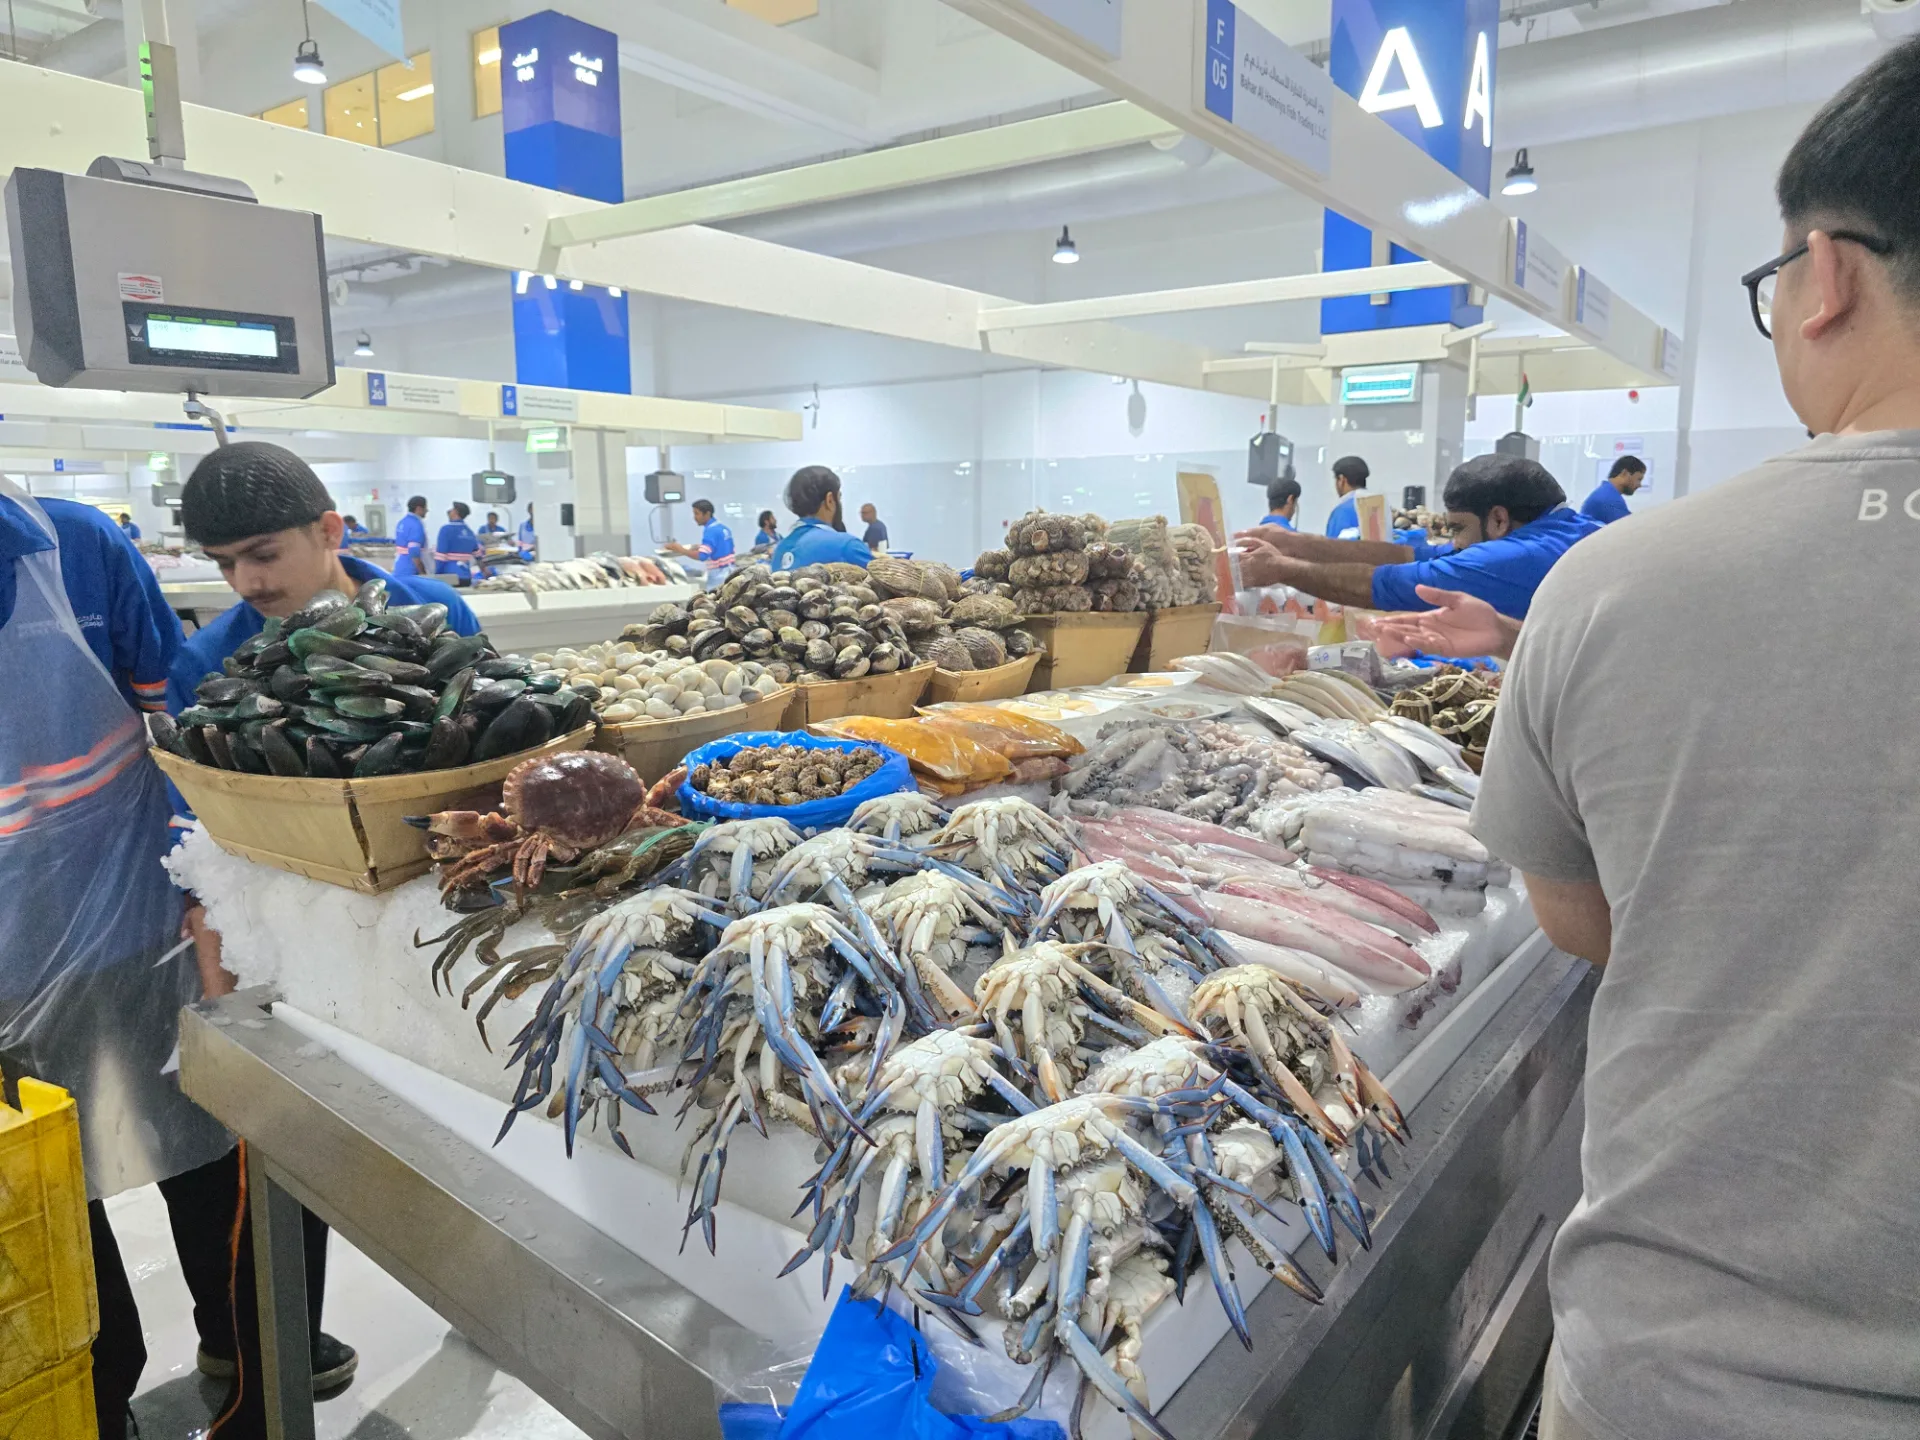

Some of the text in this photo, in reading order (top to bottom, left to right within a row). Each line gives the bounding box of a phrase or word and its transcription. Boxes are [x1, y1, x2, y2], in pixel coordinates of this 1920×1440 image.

[1216, 18, 1225, 45] F
[1212, 58, 1228, 90] 05
[1358, 26, 1444, 128] A
[1463, 31, 1491, 148] A
[1257, 85, 1265, 100] Al
